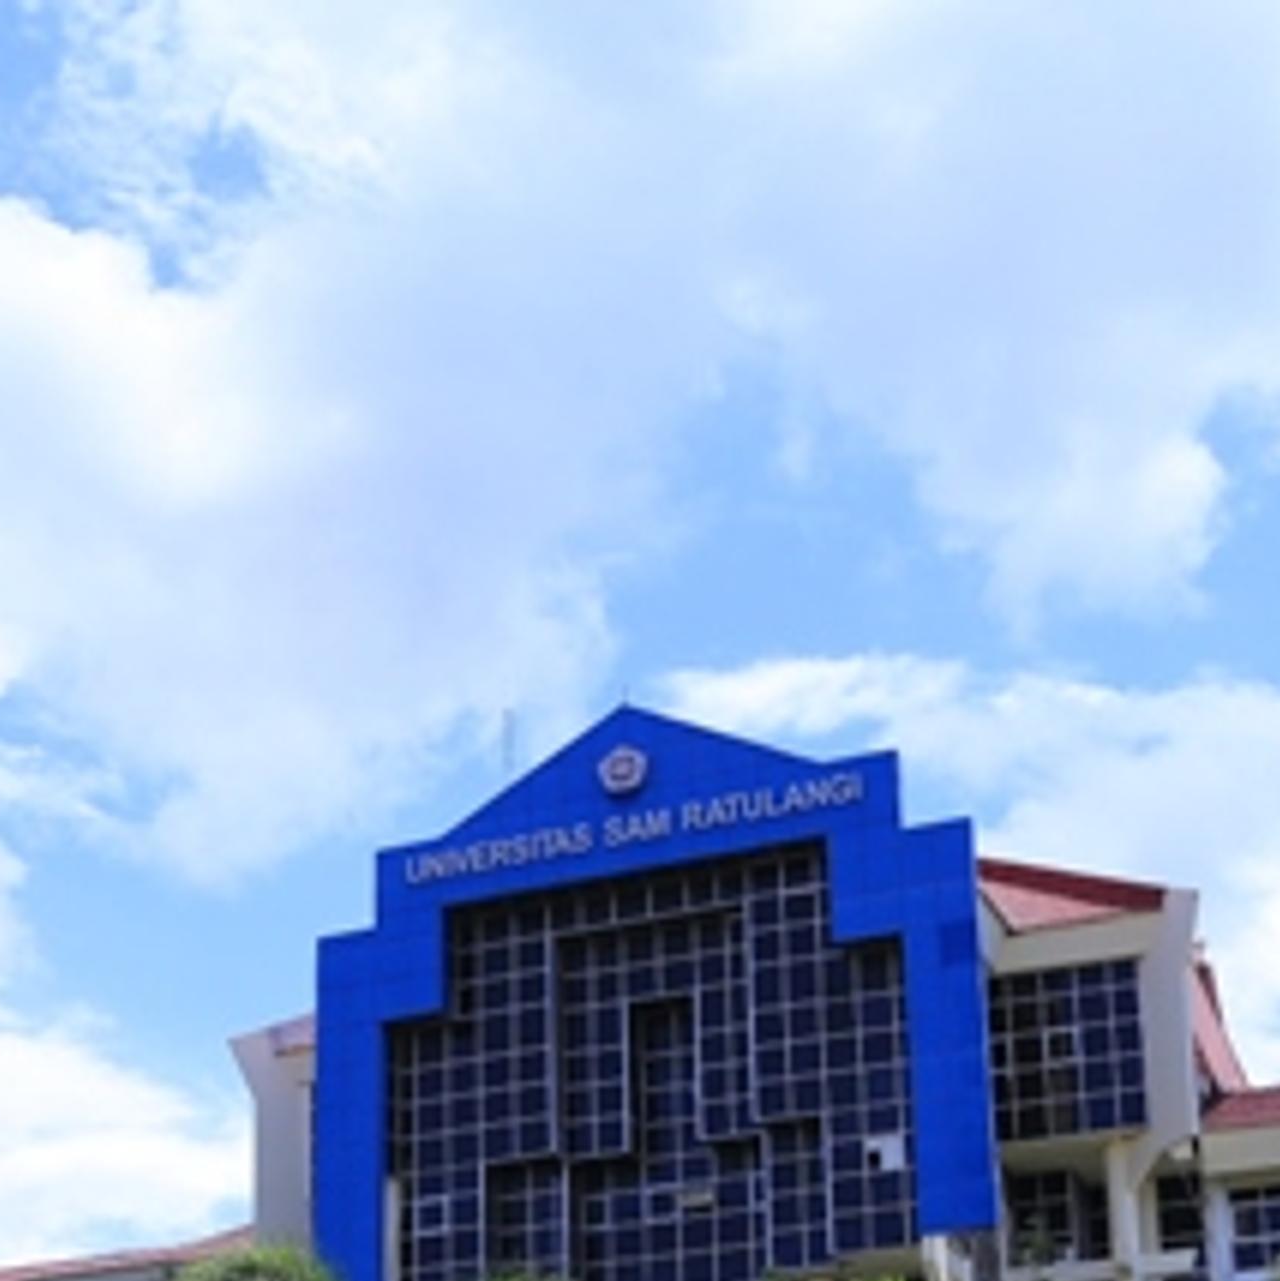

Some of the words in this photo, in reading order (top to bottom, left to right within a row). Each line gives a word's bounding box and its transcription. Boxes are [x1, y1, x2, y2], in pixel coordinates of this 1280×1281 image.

[405, 822, 593, 884] UNIVERSITAS
[603, 807, 672, 848] SAM
[681, 772, 863, 833] RATULANGI
